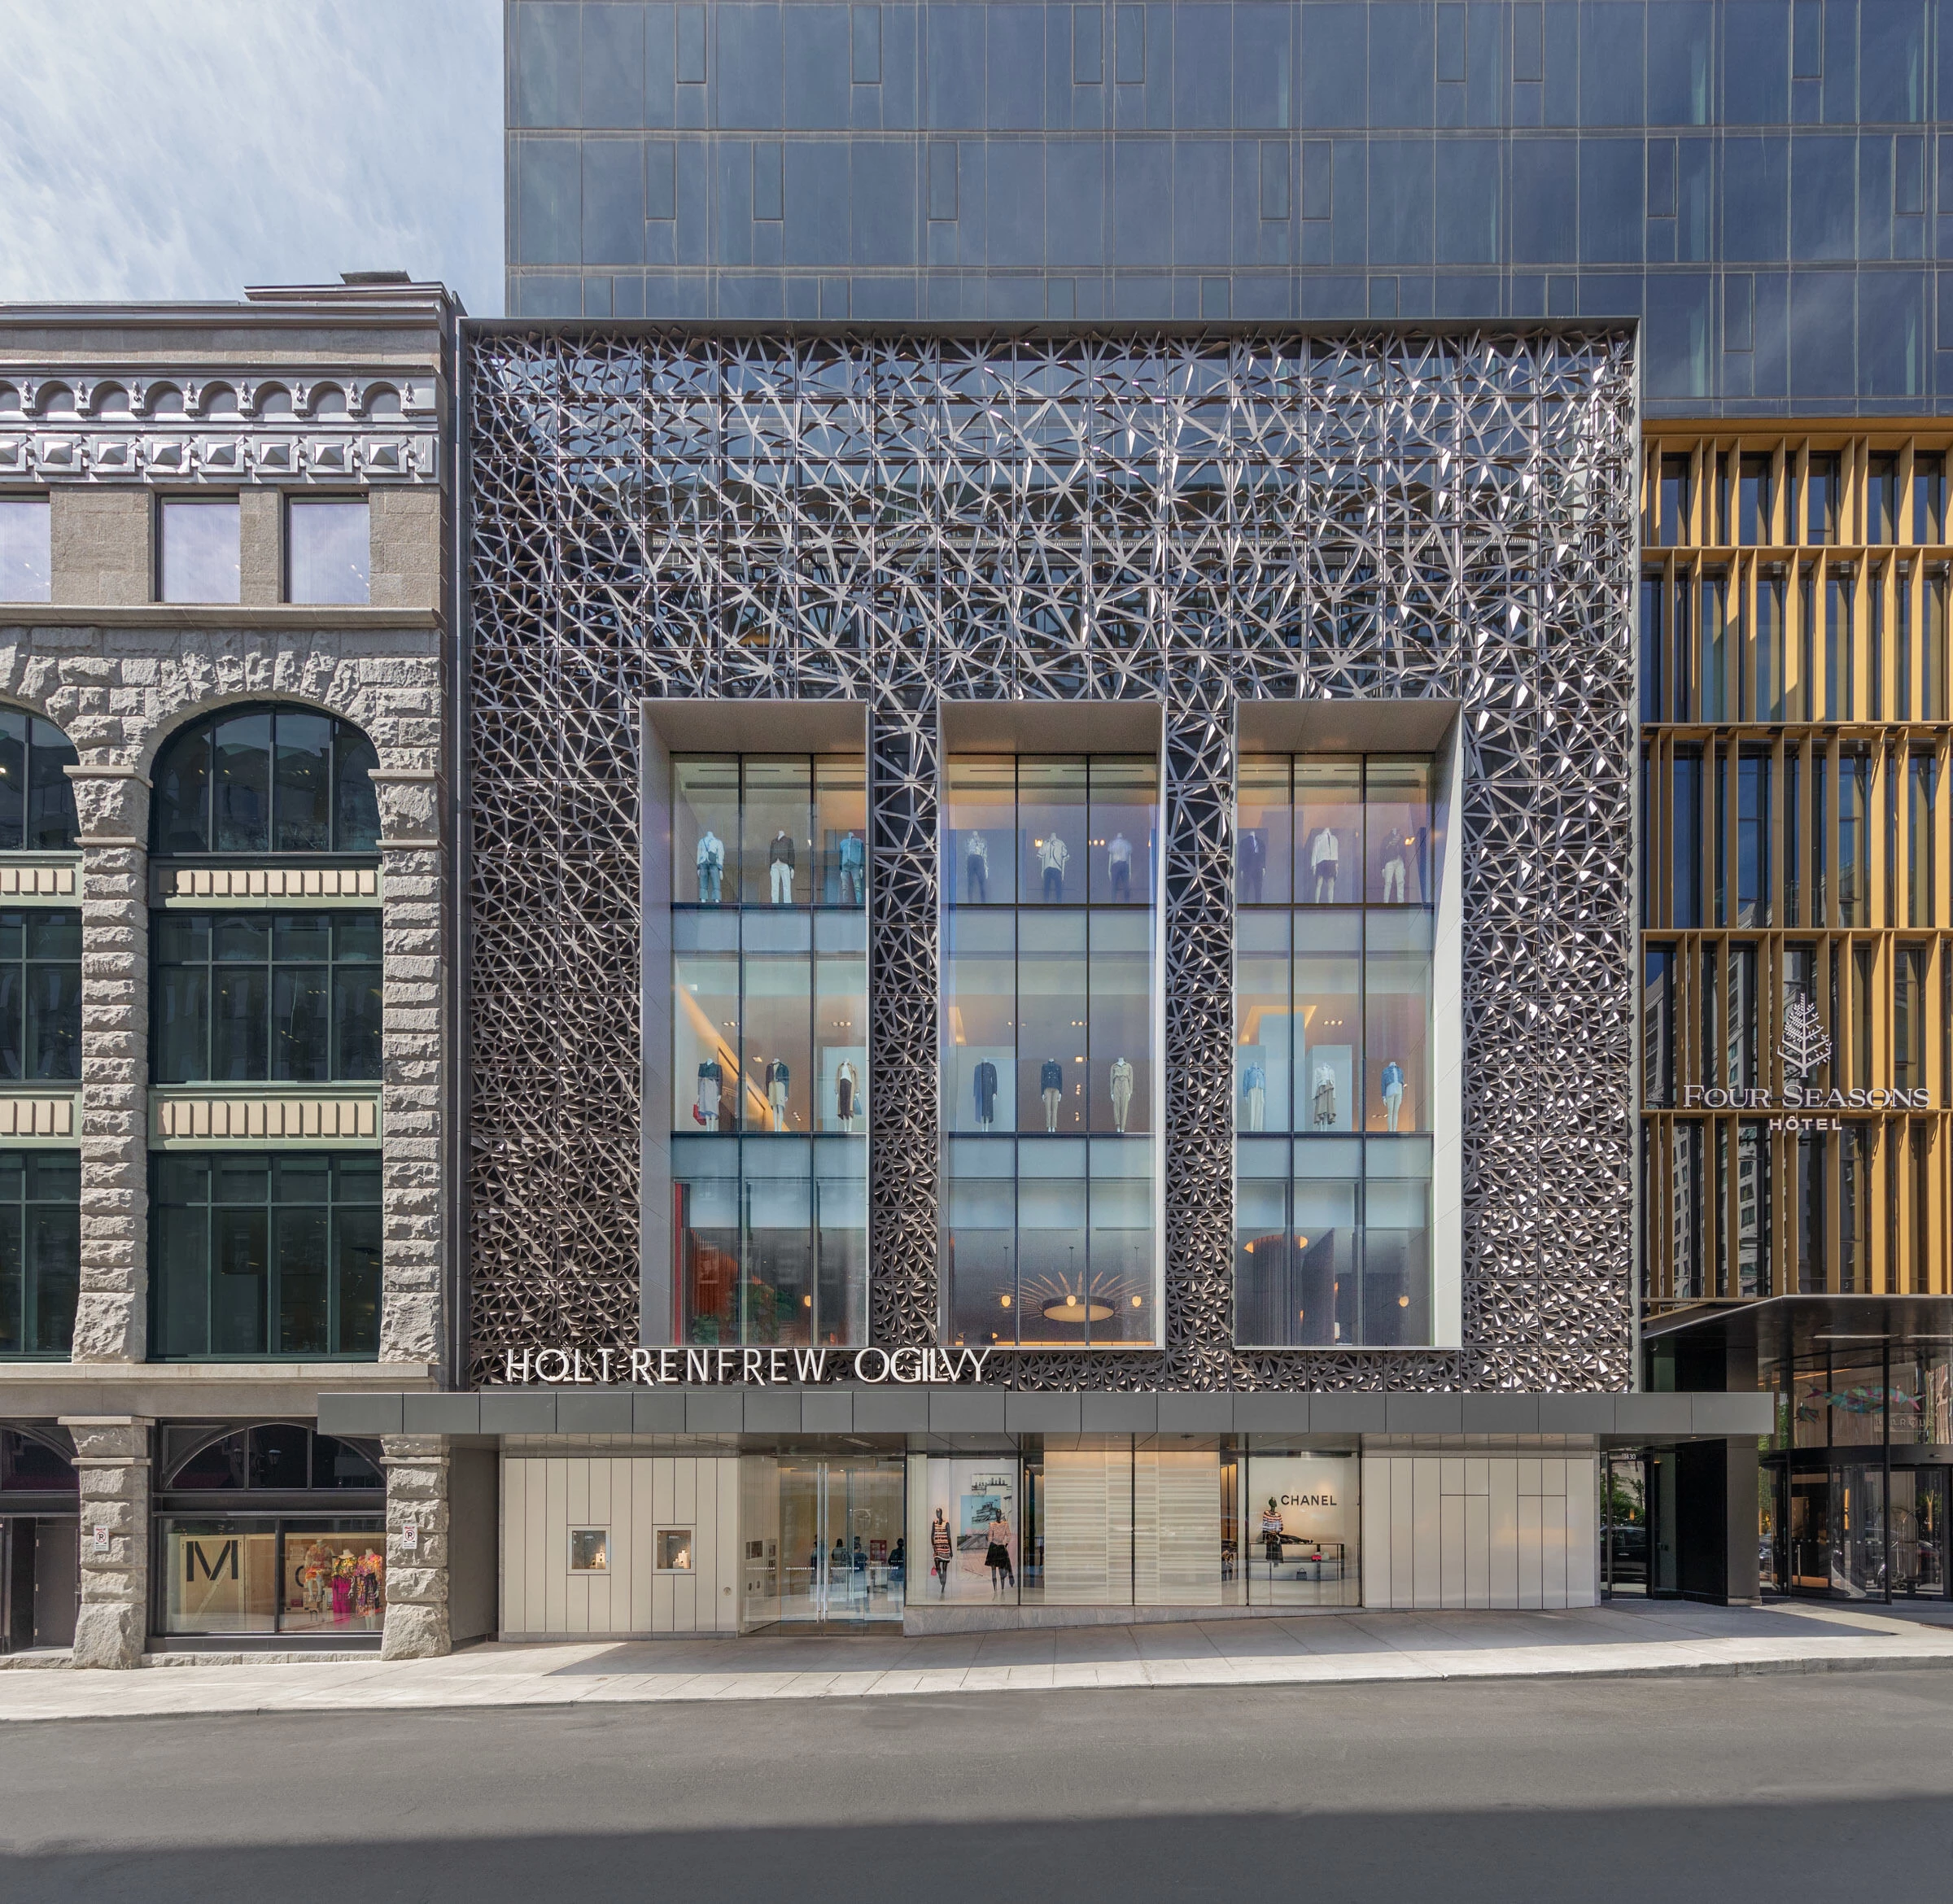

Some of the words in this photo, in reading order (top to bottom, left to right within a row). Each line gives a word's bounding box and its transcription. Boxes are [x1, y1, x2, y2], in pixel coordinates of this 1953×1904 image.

[1683, 1085, 1772, 1108] FOUR
[1782, 1084, 1931, 1108] SEASONS
[1769, 1116, 1843, 1131] HÔTEL
[506, 1347, 615, 1383] HOLT
[631, 1347, 827, 1387] RENFREW
[854, 1346, 991, 1383] OGILVY
[1280, 1495, 1337, 1505] CHANEL
